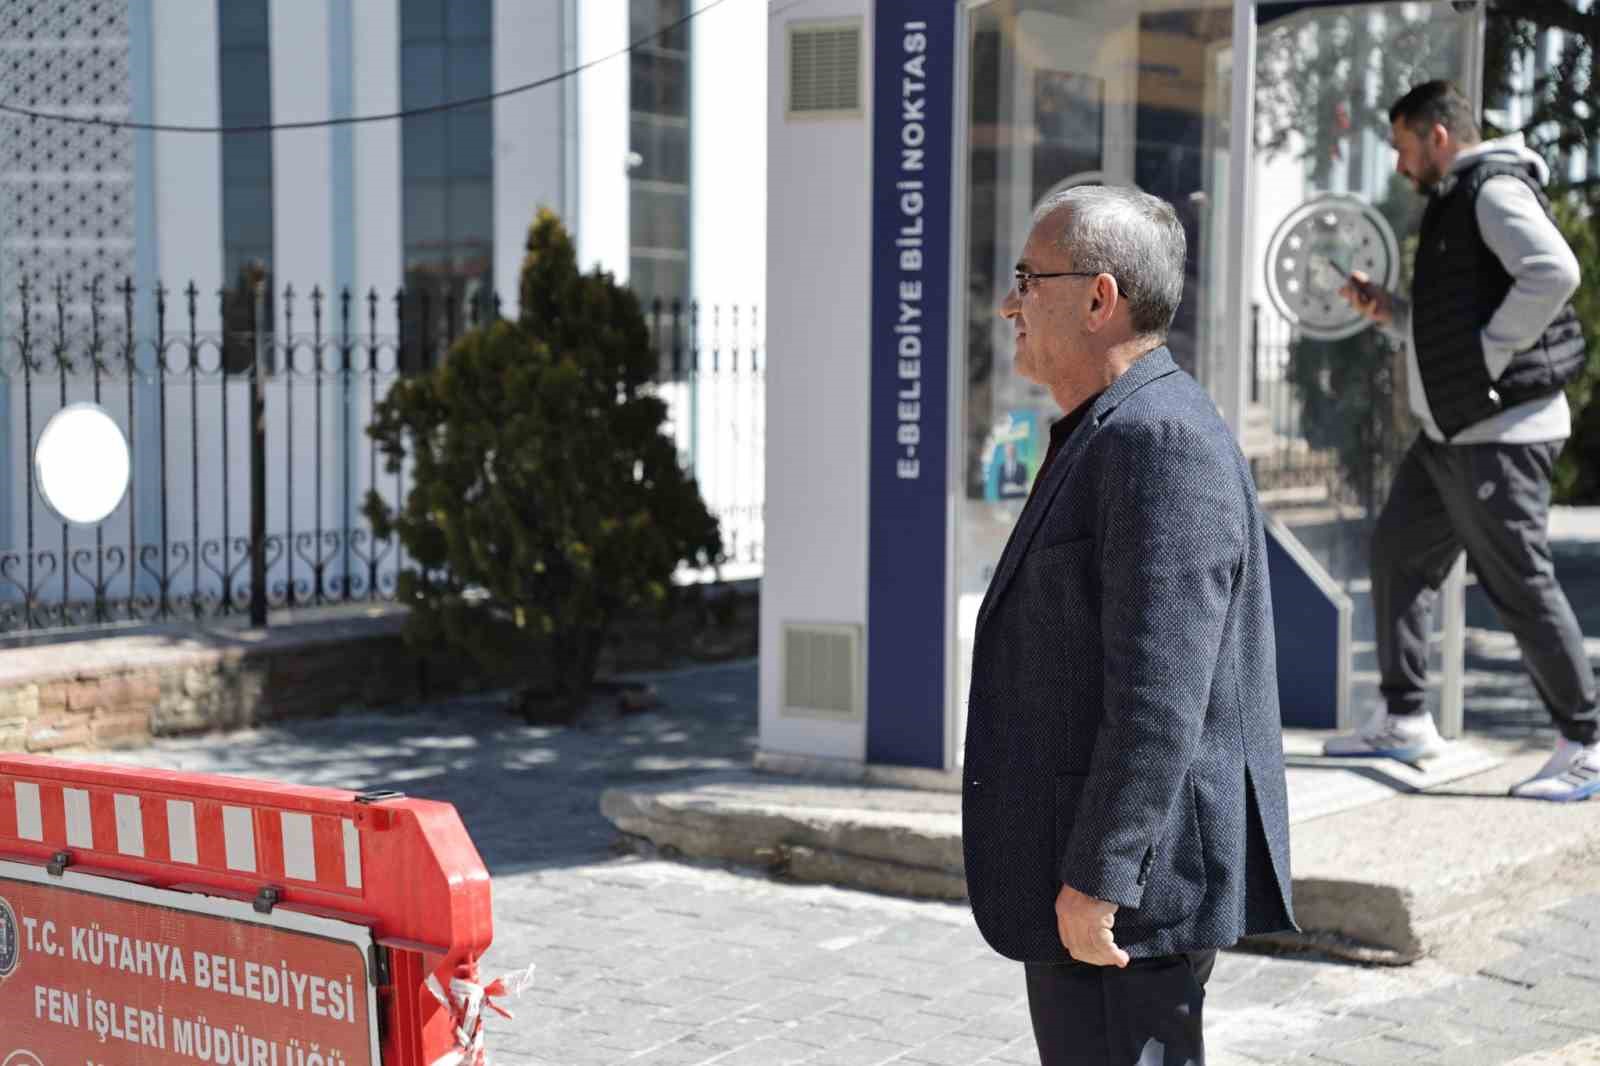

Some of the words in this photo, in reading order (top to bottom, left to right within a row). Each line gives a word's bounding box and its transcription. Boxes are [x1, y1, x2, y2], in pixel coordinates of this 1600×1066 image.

[901, 21, 927, 171] NOKTASI
[896, 181, 924, 270] BİLGİ
[893, 281, 922, 479] E-BELEDİYE
[22, 917, 65, 957] T.C.
[71, 922, 187, 985] KÜTAHYA
[193, 950, 355, 1024] BELEDİYESİ
[34, 985, 79, 1027] FEN
[86, 988, 166, 1049] İŞLERİ
